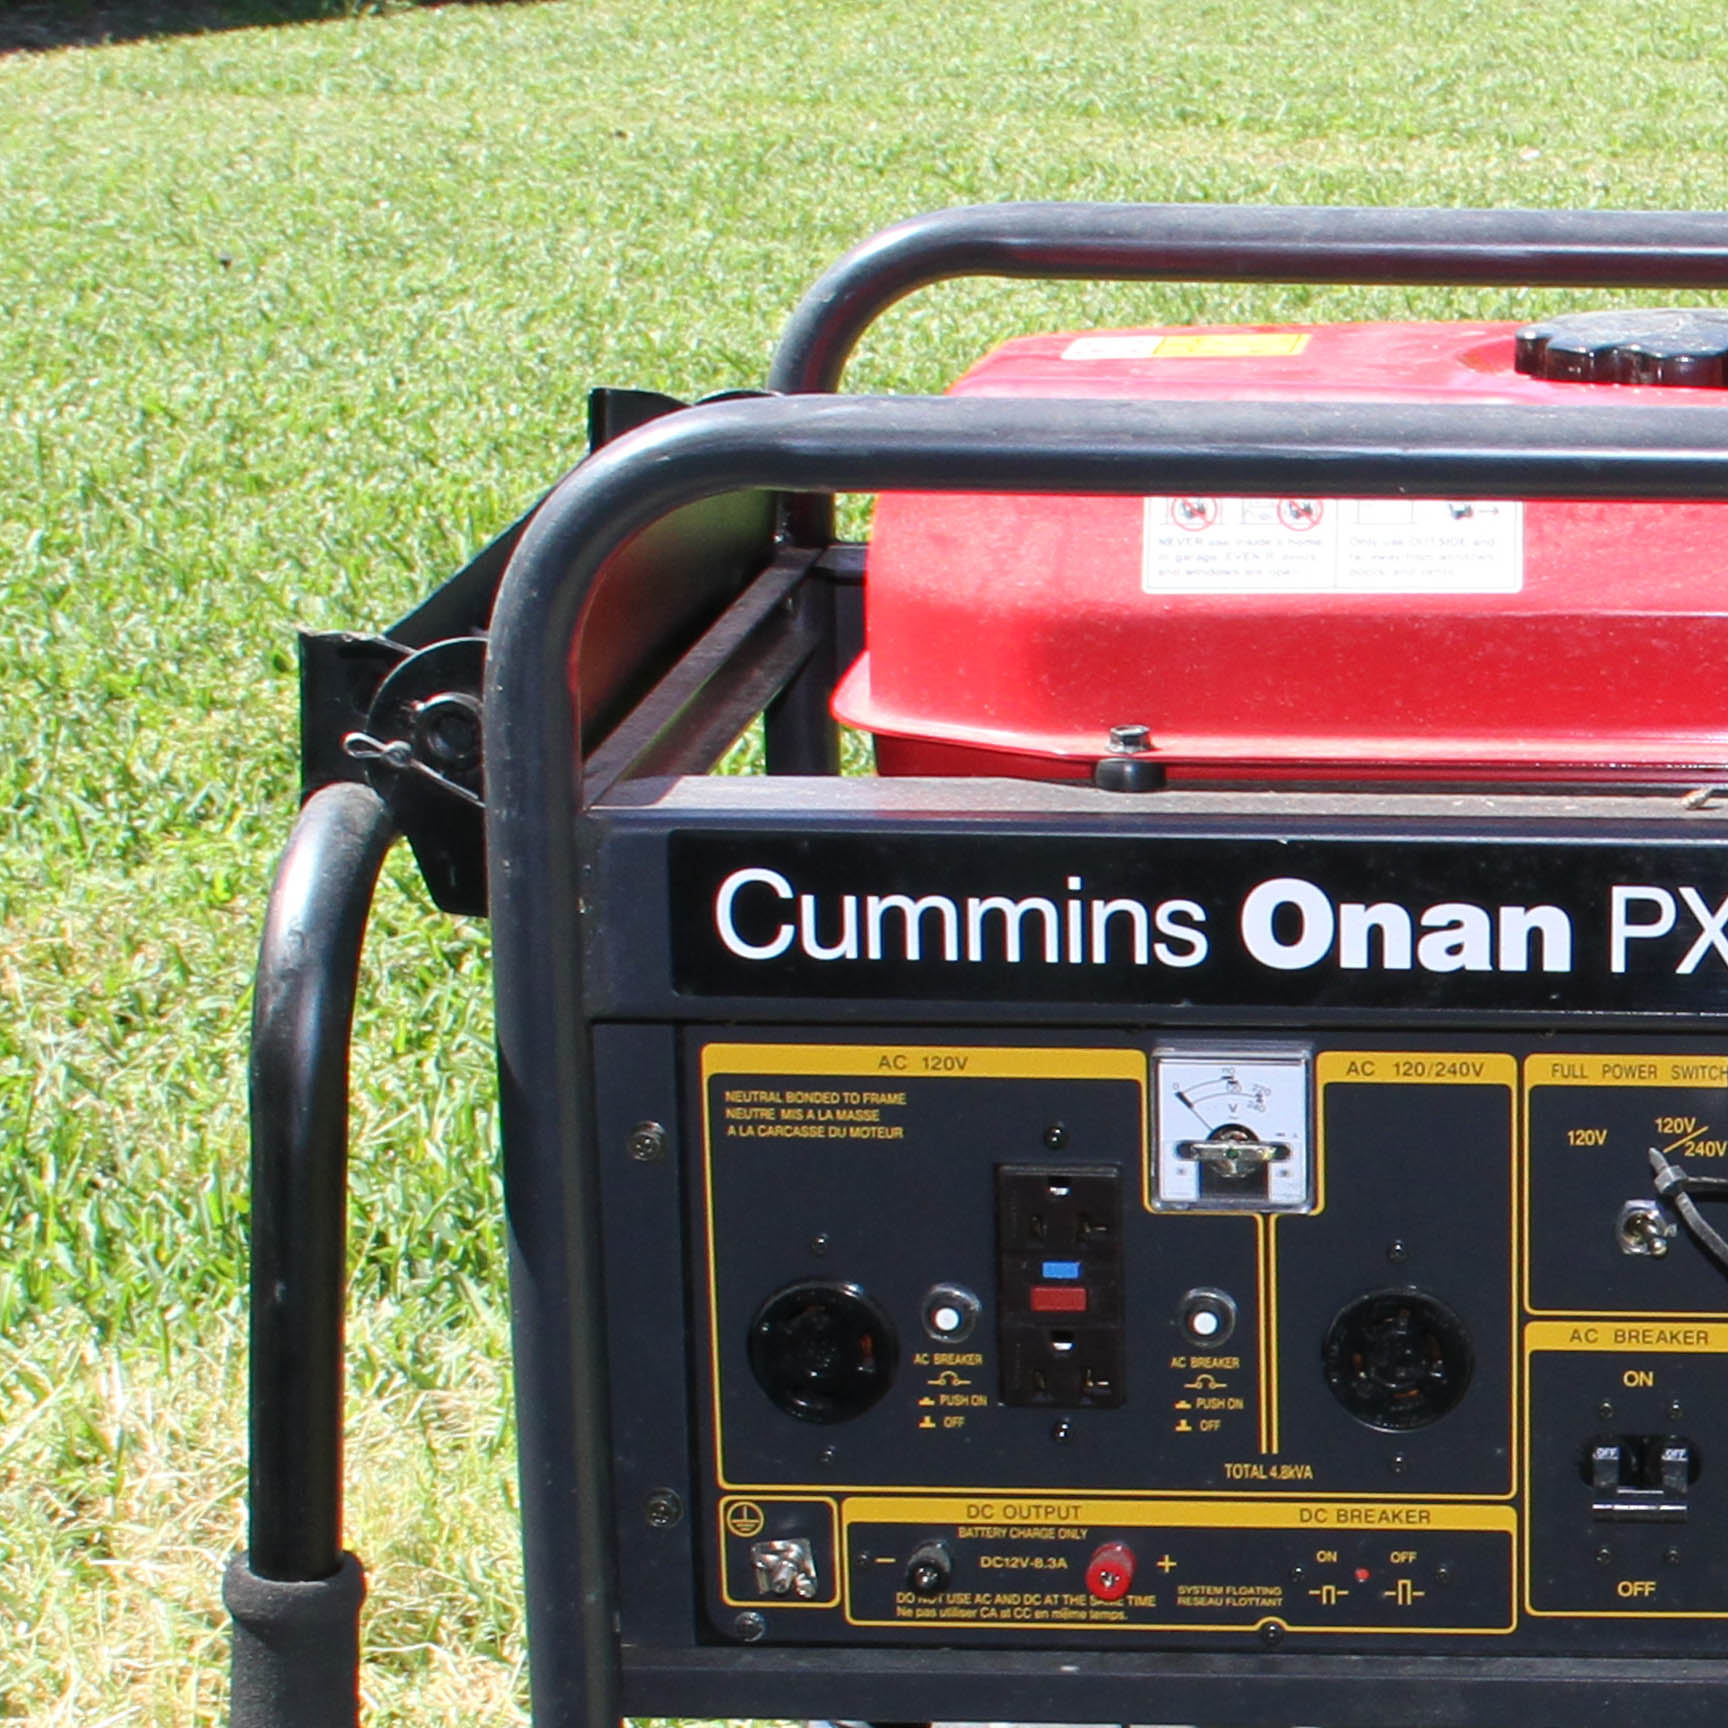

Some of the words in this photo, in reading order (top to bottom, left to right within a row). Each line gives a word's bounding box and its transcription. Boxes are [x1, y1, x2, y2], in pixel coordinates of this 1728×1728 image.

[713, 867, 1209, 969] Cummins
[1241, 877, 1572, 973] Onan
[878, 1055, 908, 1071] AC
[922, 1055, 969, 1072] 120V
[1345, 1062, 1376, 1078] AC
[1393, 1061, 1486, 1079] 120/240V
[1551, 1063, 1589, 1080] FULL
[1602, 1064, 1658, 1081] POWER
[724, 1090, 783, 1103] NEUTRAL
[785, 1091, 840, 1105] BONDED
[842, 1091, 861, 1105] TO
[862, 1092, 907, 1106] FRAME
[724, 1107, 775, 1120] NEUTRE
[780, 1108, 805, 1121] MIS
[817, 1109, 834, 1122] LA
[836, 1109, 881, 1122] MASSE
[738, 1125, 755, 1138] LA
[756, 1125, 826, 1139] CARCASSE
[827, 1126, 846, 1139] DU
[848, 1126, 905, 1140] MOTEUR
[1655, 1117, 1697, 1135] 120V
[1567, 1129, 1608, 1147] 120V
[1684, 1140, 1728, 1158] 240V
[1569, 1328, 1599, 1344] AC
[1614, 1329, 1709, 1346] BREAKER
[913, 1352, 931, 1366] AC
[933, 1352, 983, 1367] BREAKER
[1170, 1356, 1187, 1368] AC
[1190, 1356, 1241, 1369] BREAKER
[1623, 1370, 1654, 1388] ON
[939, 1394, 969, 1407] PUSH
[970, 1394, 988, 1407] ON
[1196, 1397, 1226, 1410] PUSH
[1227, 1398, 1245, 1411] ON
[943, 1415, 966, 1429] OFF
[1199, 1419, 1222, 1432] OFF
[1224, 1463, 1269, 1480] TOTAL
[966, 1503, 994, 1520] DC
[1002, 1504, 1083, 1521] OUTPUT
[1299, 1507, 1330, 1524] DC
[1336, 1507, 1431, 1525] BREAKER
[957, 1526, 1008, 1539] BATTERY
[1009, 1527, 1056, 1540] CHARGE
[1057, 1528, 1088, 1540] ONLY
[979, 1555, 1069, 1570] DC12V-8.3A
[1316, 1550, 1338, 1563] ON
[1390, 1550, 1418, 1564] OFF
[1176, 1585, 1224, 1596] SYSTEM
[1225, 1586, 1283, 1597] FLOATING
[1617, 1580, 1657, 1598] OFF
[896, 1591, 915, 1604] DO
[946, 1593, 972, 1605] USE
[974, 1593, 993, 1605] AC
[994, 1594, 1020, 1606] AND
[1023, 1594, 1042, 1606] DC
[1043, 1594, 1059, 1606] AT
[1061, 1594, 1087, 1607] THE
[1126, 1595, 1157, 1608] TIME
[1225, 1597, 1283, 1608] FLOTTANT
[980, 1607, 999, 1618] CA
[1013, 1608, 1032, 1619] CC
